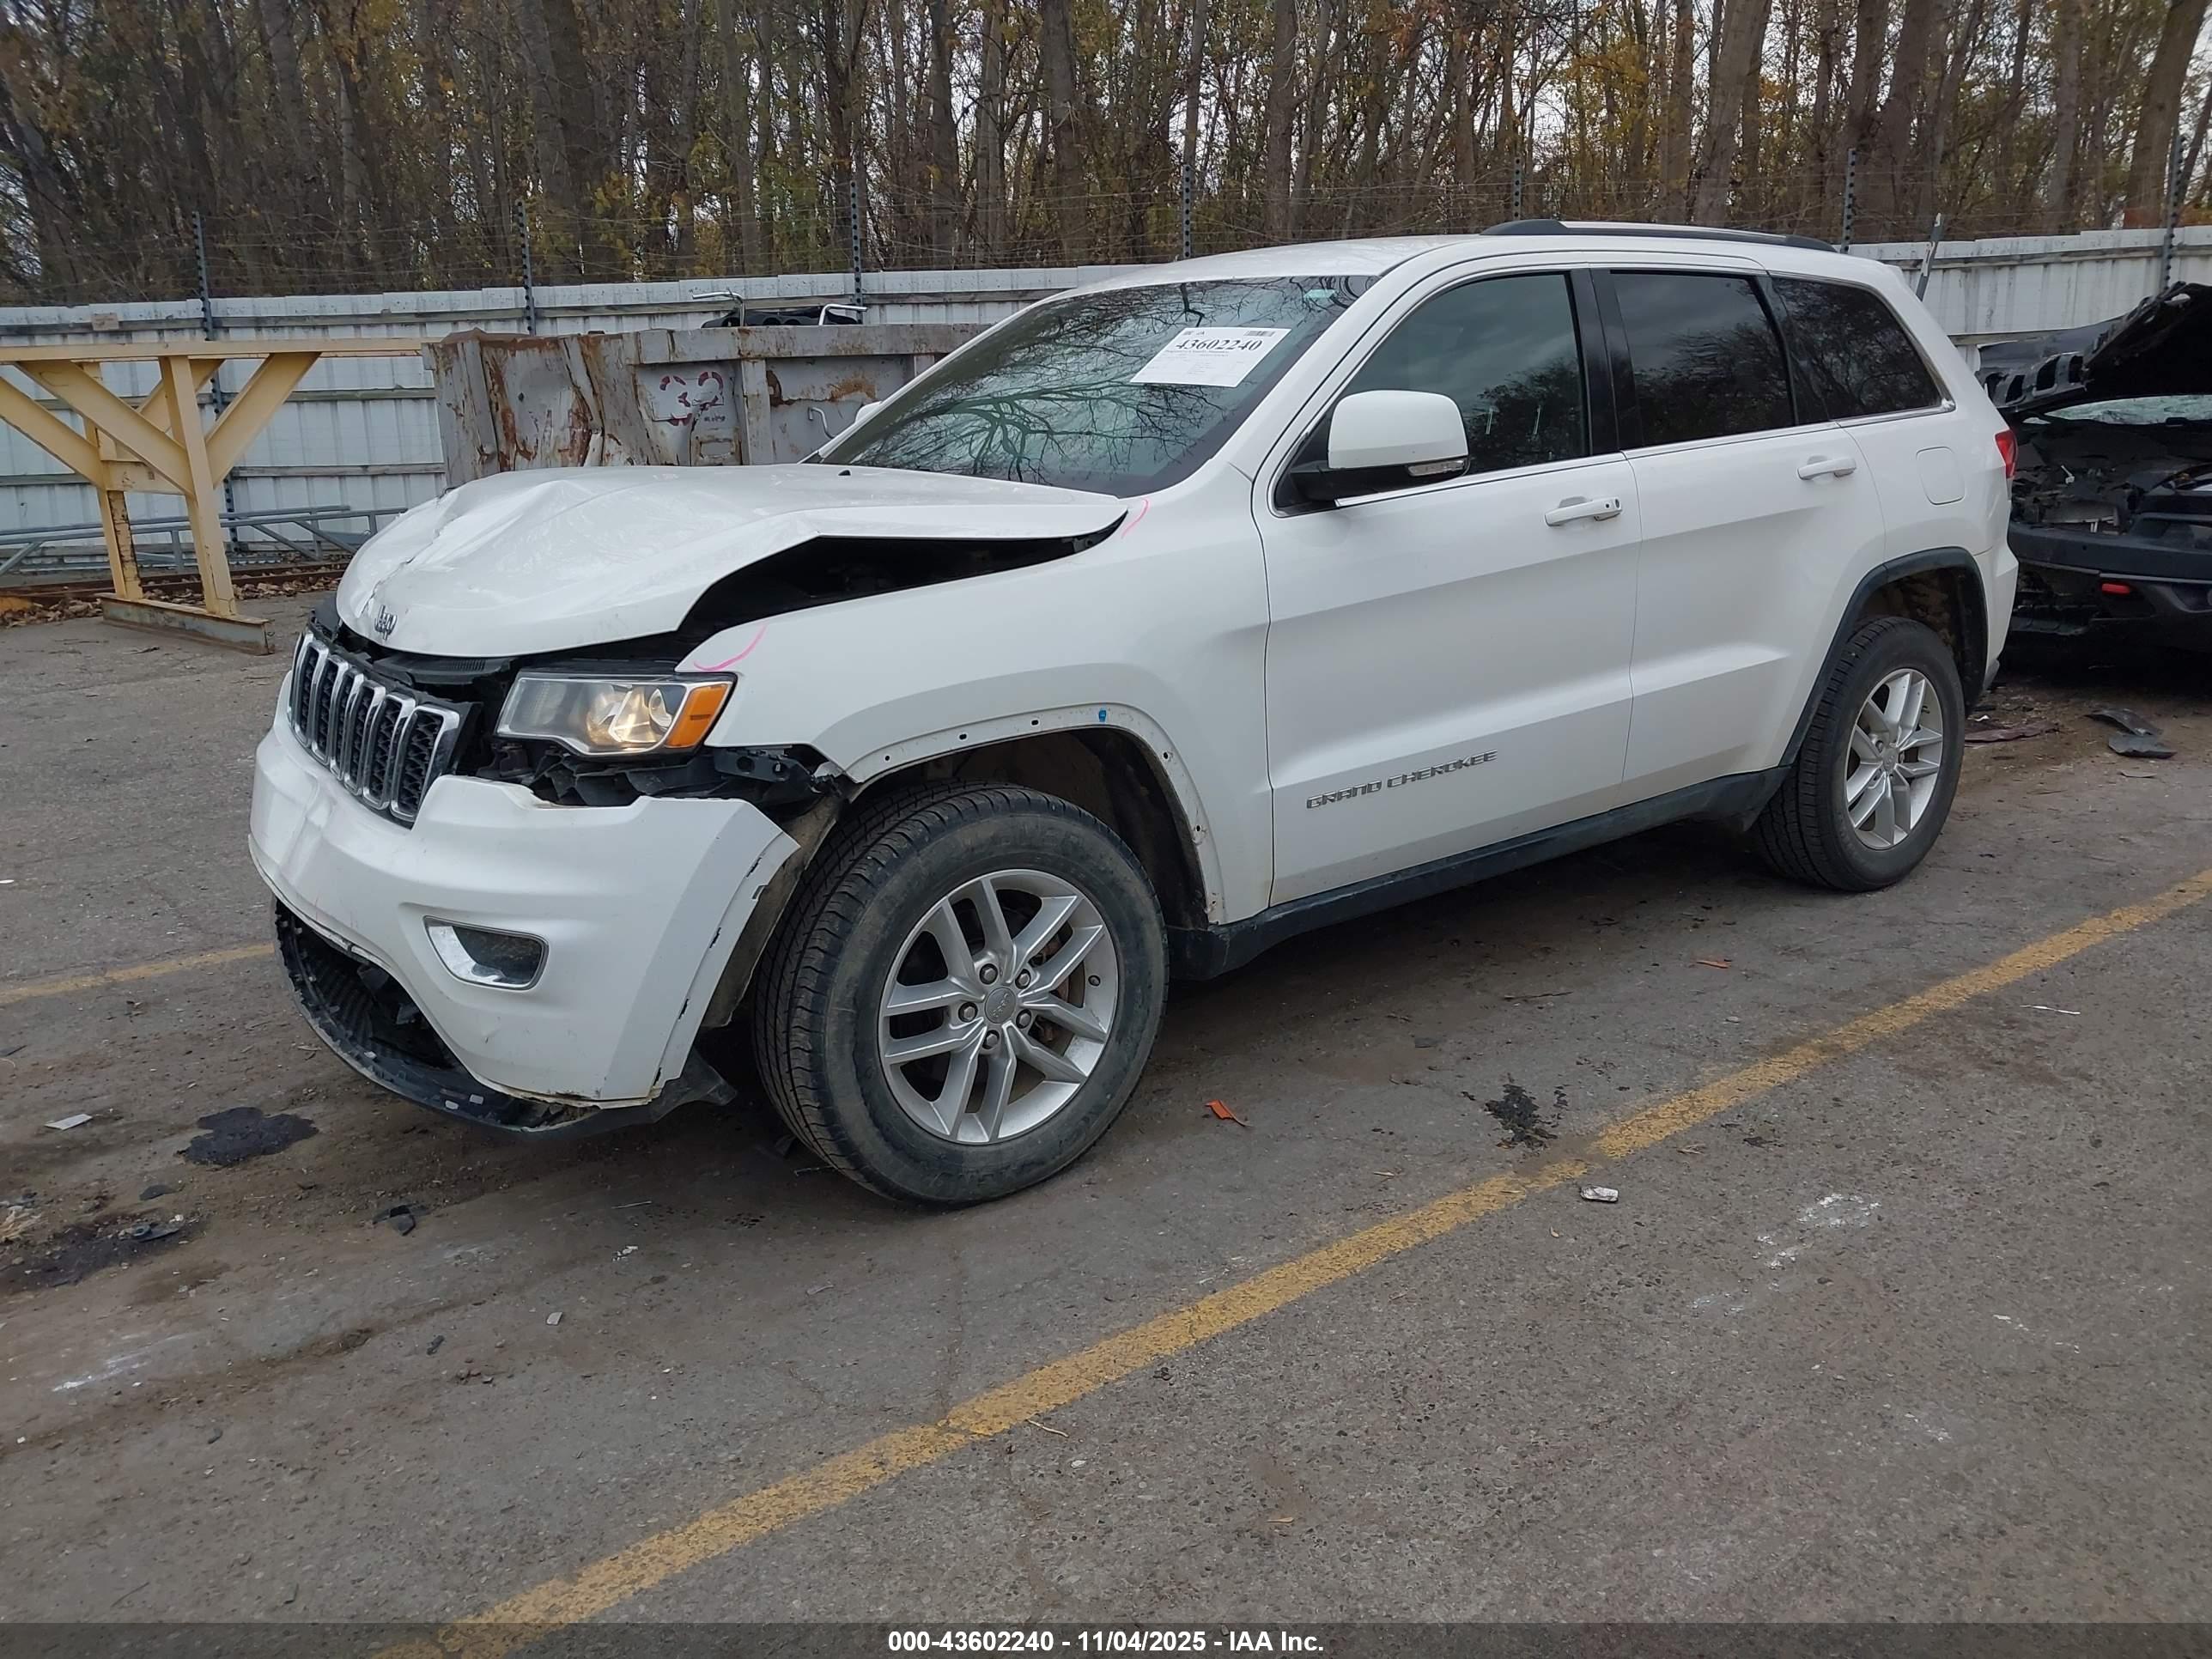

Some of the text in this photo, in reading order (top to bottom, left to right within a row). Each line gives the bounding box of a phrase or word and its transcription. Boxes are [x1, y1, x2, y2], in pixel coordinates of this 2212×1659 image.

[1176, 339, 1263, 351] 43602240
[374, 604, 398, 641] Jeep
[1306, 749, 1498, 809] GRAND CHEROKEE
